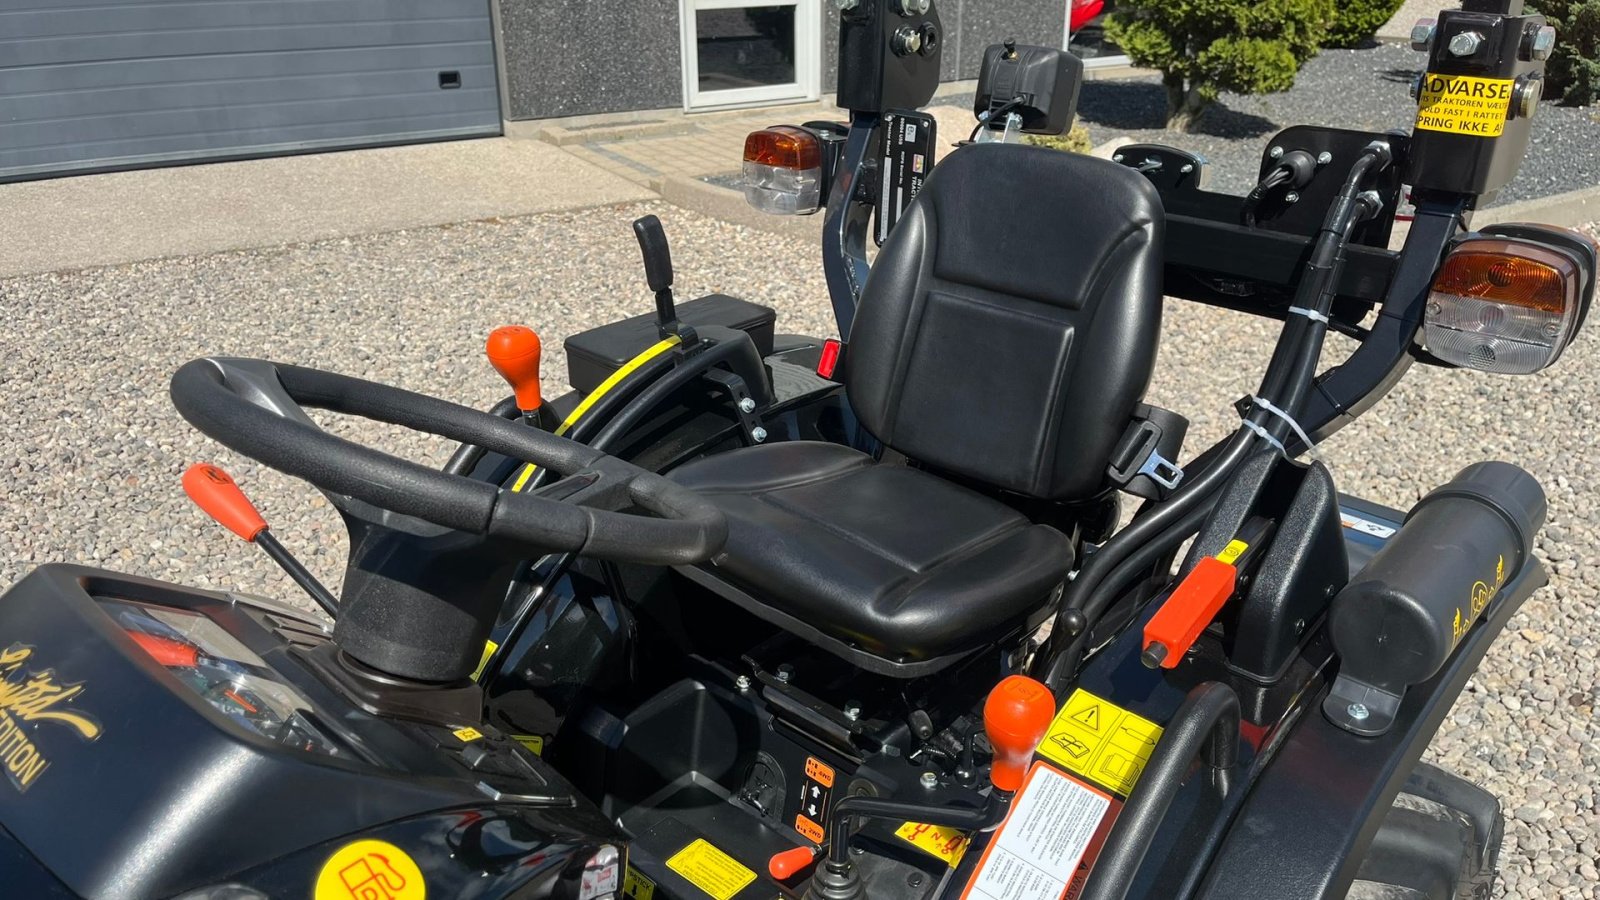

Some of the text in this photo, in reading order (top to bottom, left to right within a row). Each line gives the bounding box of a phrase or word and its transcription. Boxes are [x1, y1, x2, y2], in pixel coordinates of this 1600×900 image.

[1433, 96, 1484, 108] TRAKTOREN
[1444, 107, 1464, 117] FAST
[1473, 111, 1503, 120] RATTET
[1416, 115, 1454, 129] PRING
[1459, 120, 1489, 133] IKKE
[931, 832, 942, 842] N
